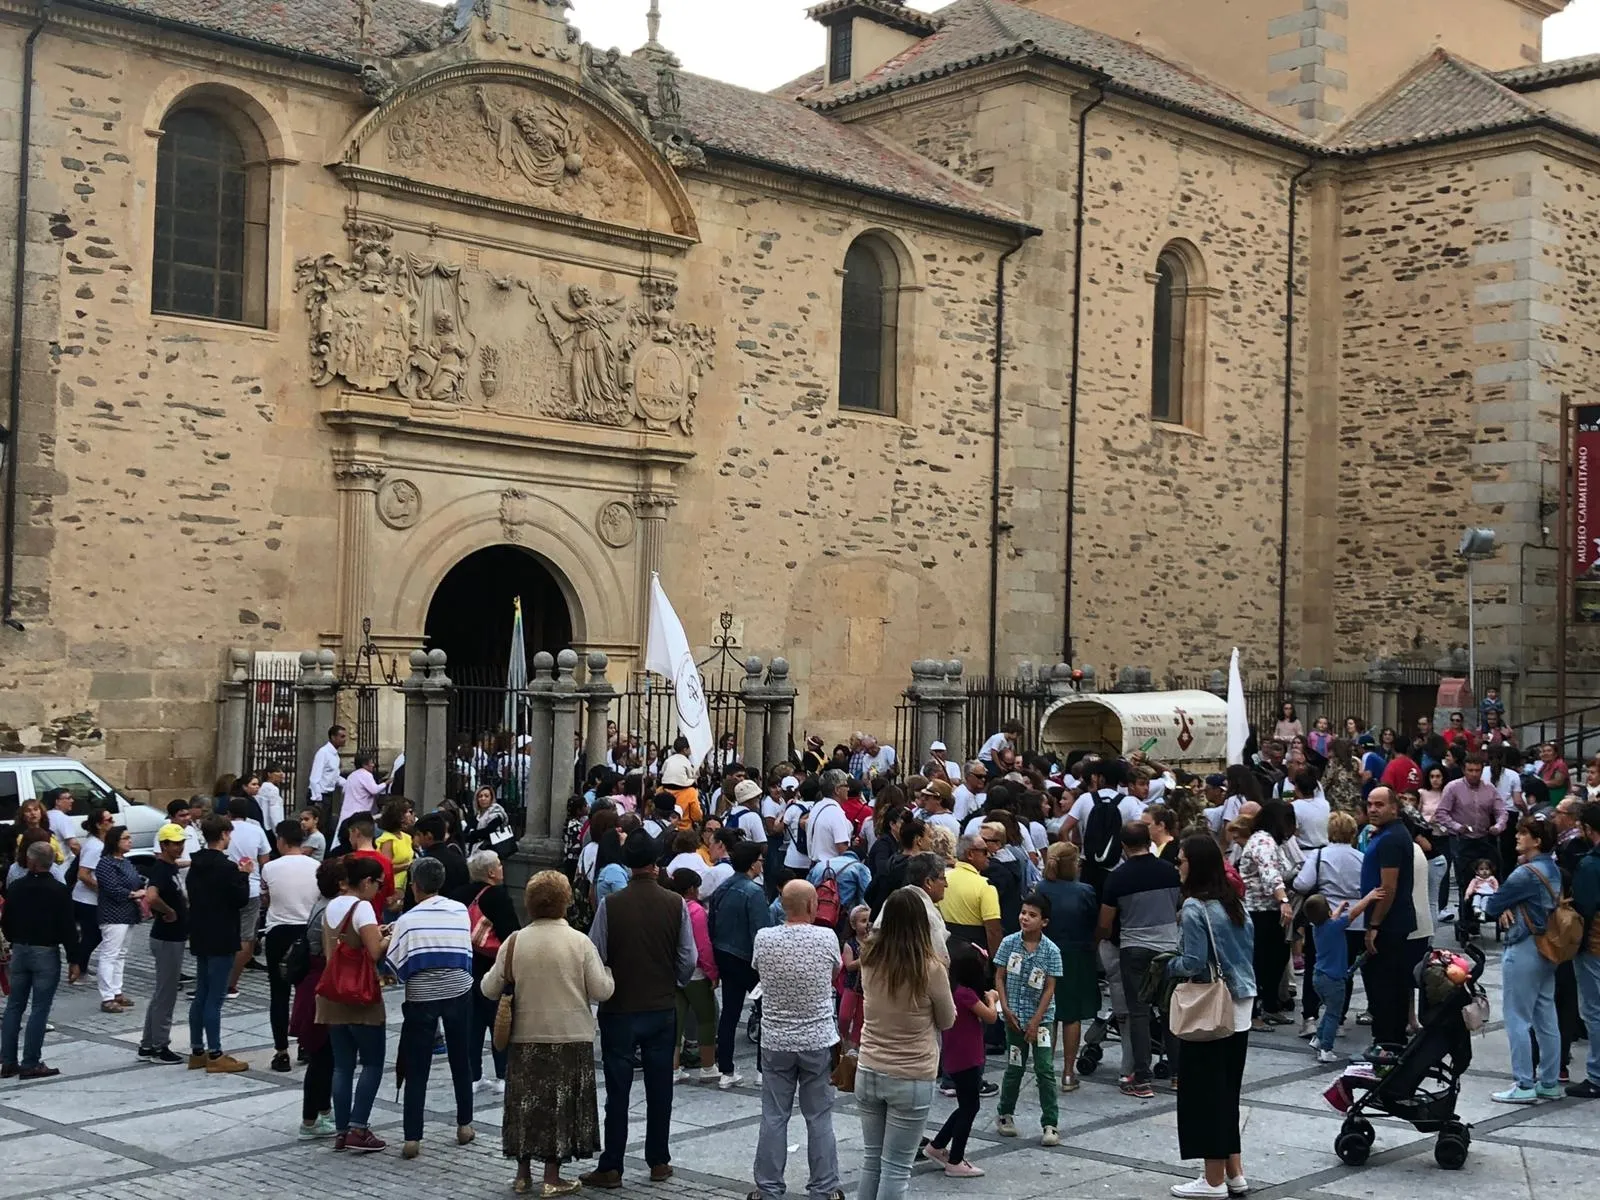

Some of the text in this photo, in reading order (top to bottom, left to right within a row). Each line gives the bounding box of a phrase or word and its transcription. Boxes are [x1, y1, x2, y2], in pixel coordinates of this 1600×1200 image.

[1577, 446, 1588, 563] MUSEO CARMELITANO
[1130, 726, 1167, 737] TERESIANA
